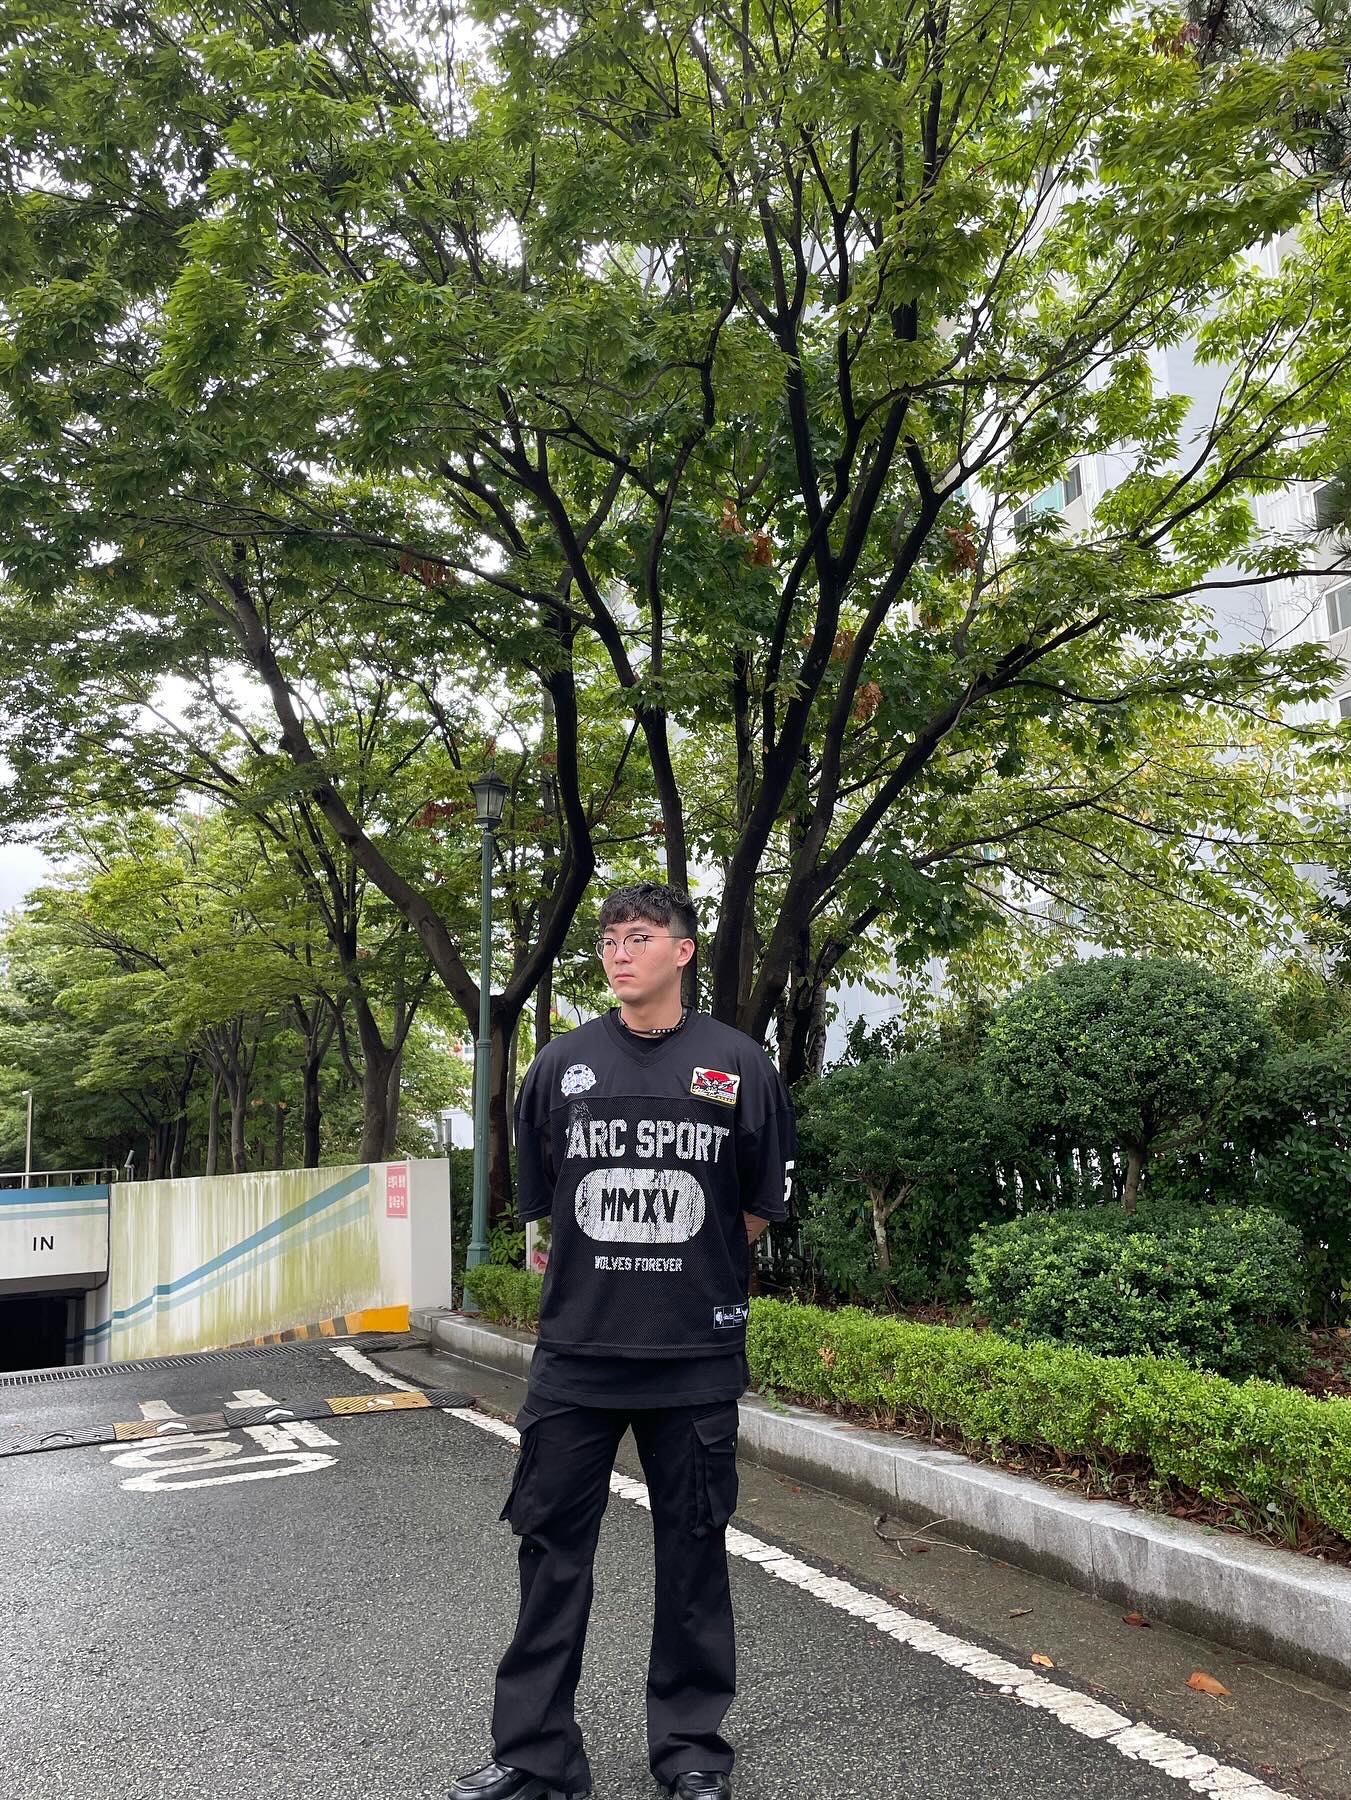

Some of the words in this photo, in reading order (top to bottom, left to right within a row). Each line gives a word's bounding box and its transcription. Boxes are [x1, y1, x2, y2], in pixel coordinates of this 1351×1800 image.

[636, 1118, 730, 1164] SPORT
[601, 1187, 680, 1224] MMXV
[33, 1235, 54, 1252] IN
[594, 1255, 632, 1271] WOLVES
[634, 1257, 683, 1272] FOREVER
